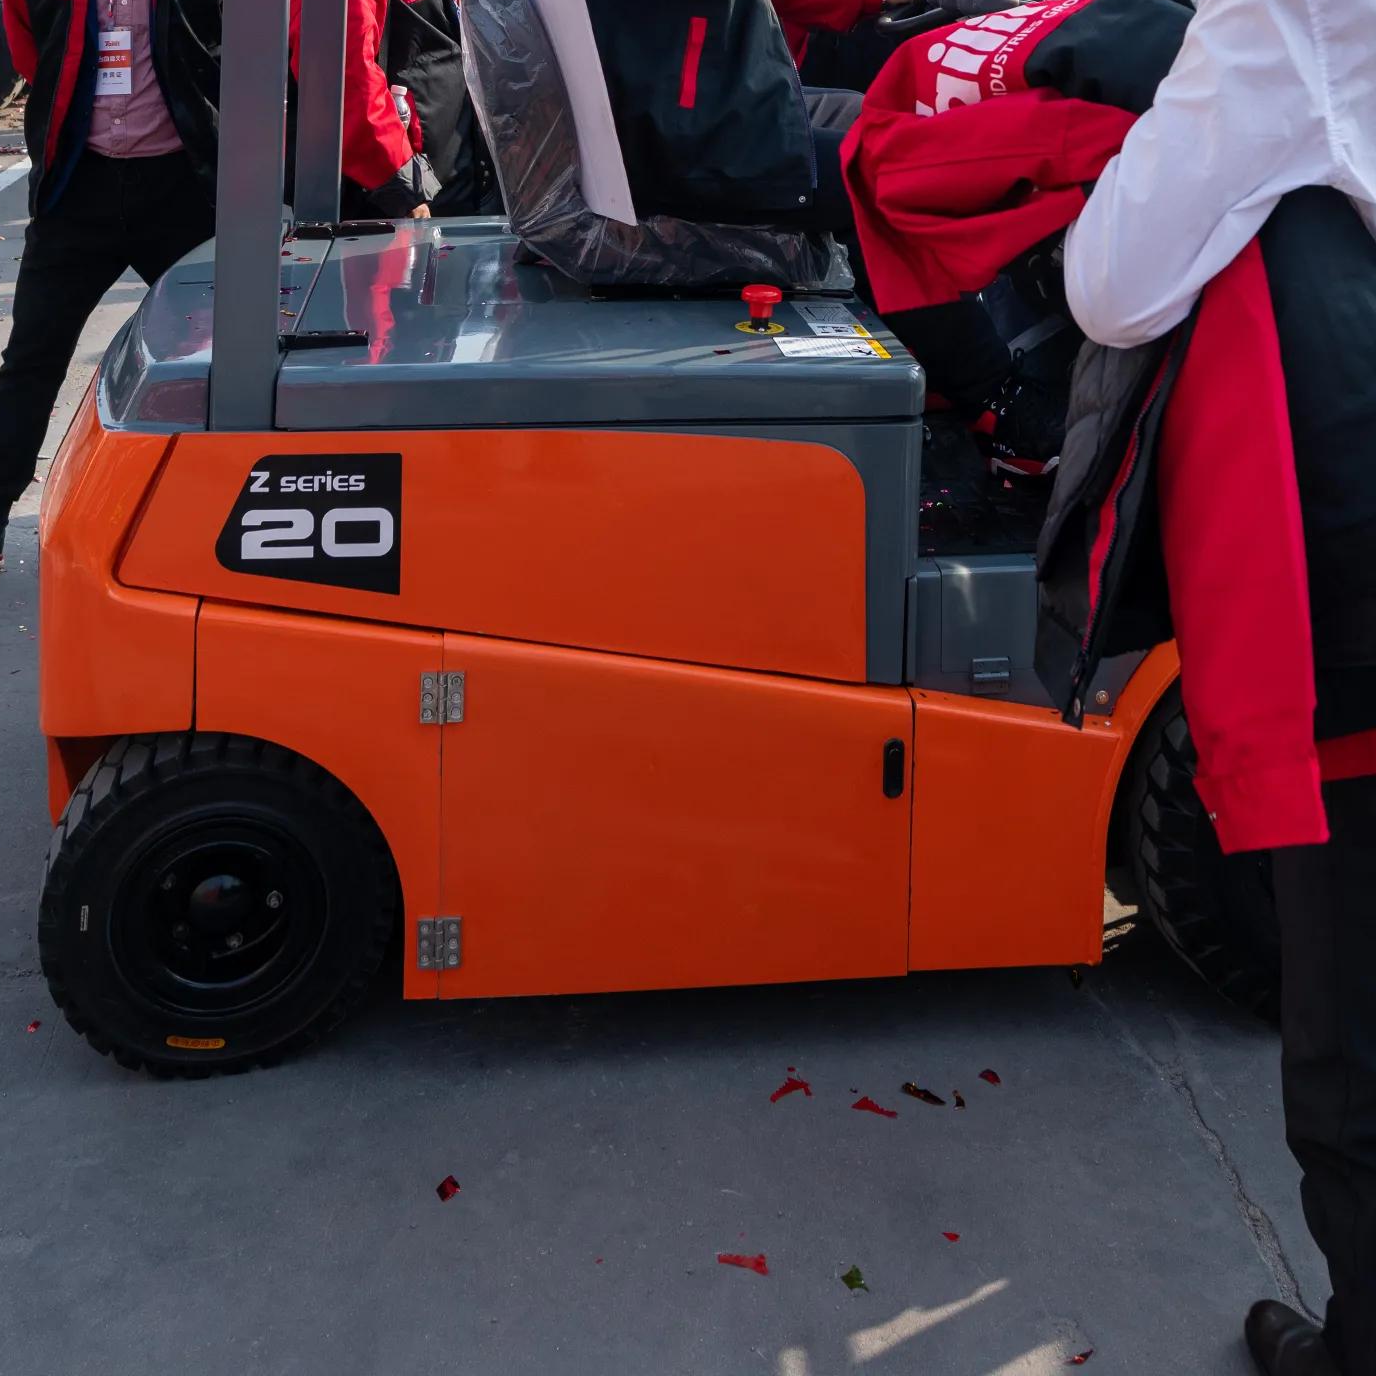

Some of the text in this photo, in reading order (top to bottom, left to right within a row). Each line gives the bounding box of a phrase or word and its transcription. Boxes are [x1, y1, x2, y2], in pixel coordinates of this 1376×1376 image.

[249, 470, 366, 493] Z series
[240, 507, 394, 560] 20
